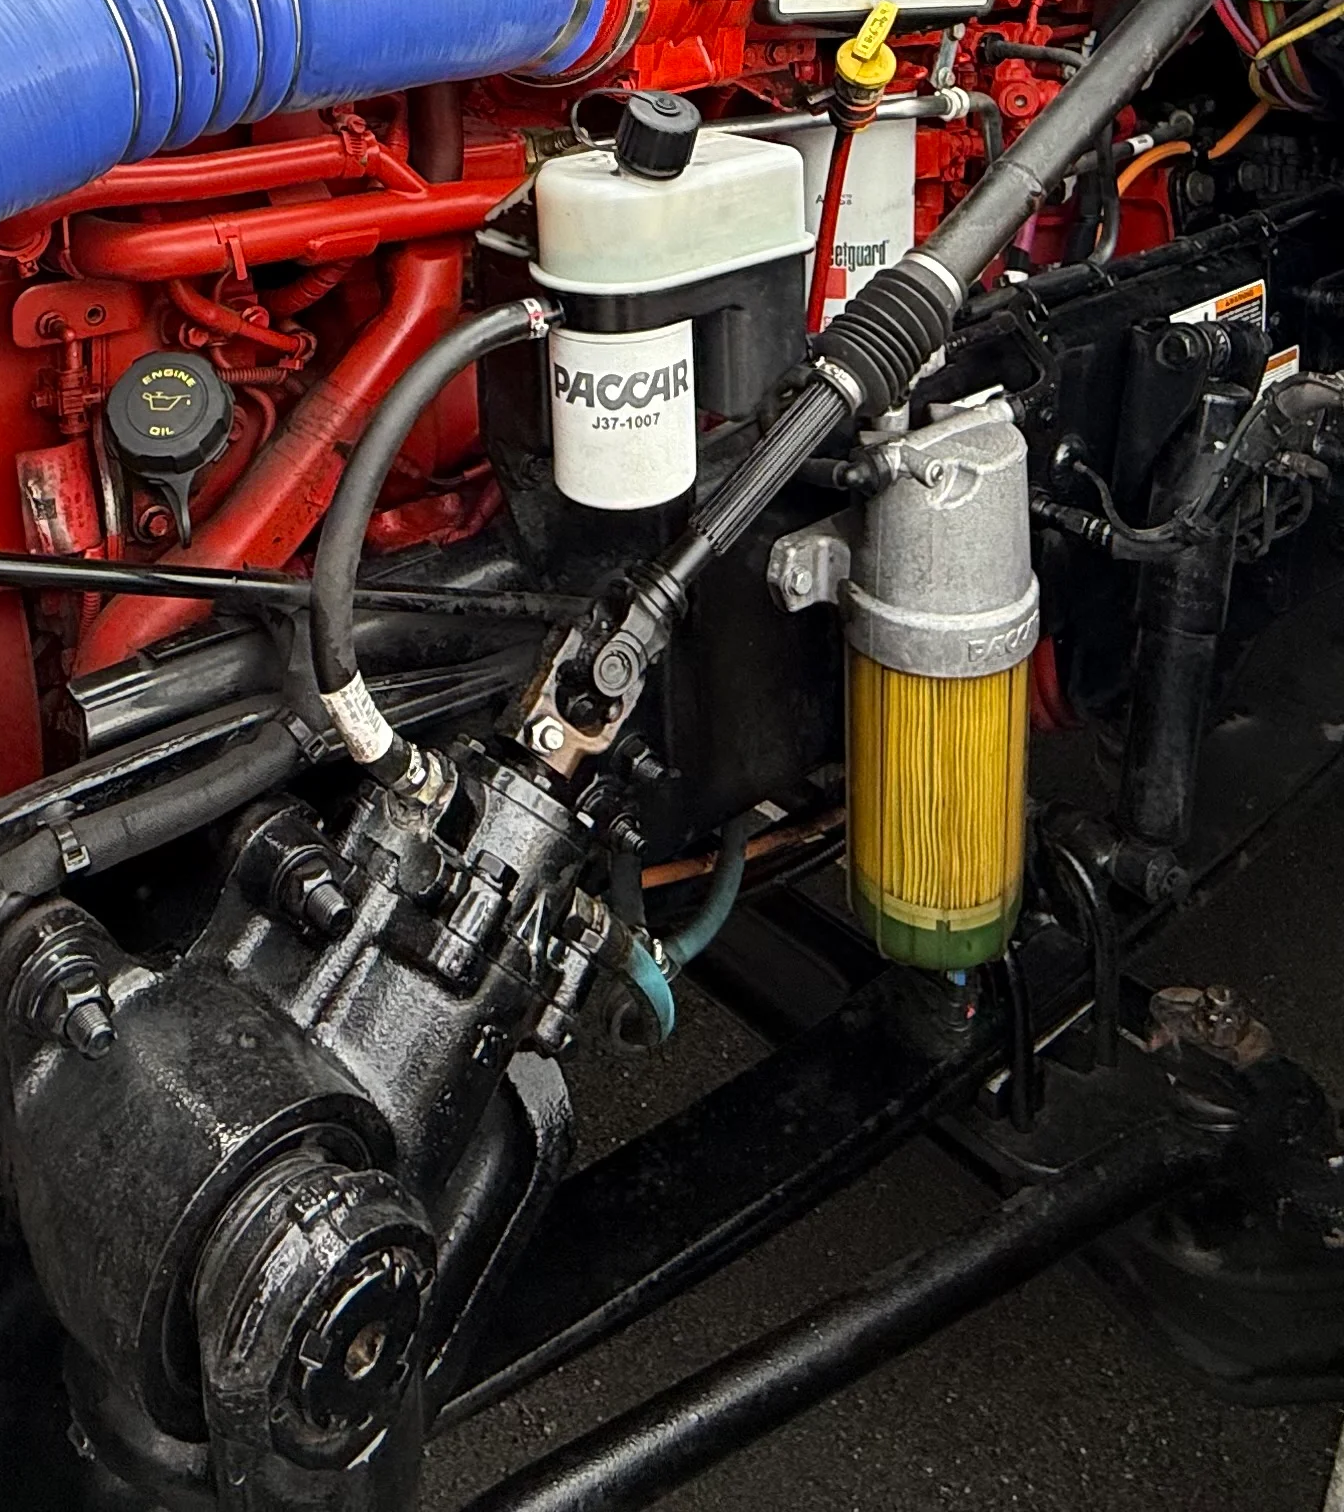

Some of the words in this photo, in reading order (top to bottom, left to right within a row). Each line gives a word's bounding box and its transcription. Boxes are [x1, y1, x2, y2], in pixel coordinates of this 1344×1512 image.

[830, 240, 886, 273] etguard
[141, 368, 196, 389] ENGINE
[553, 358, 689, 411] PACCAR
[149, 425, 175, 437] OIL
[591, 412, 662, 431] J37-1007
